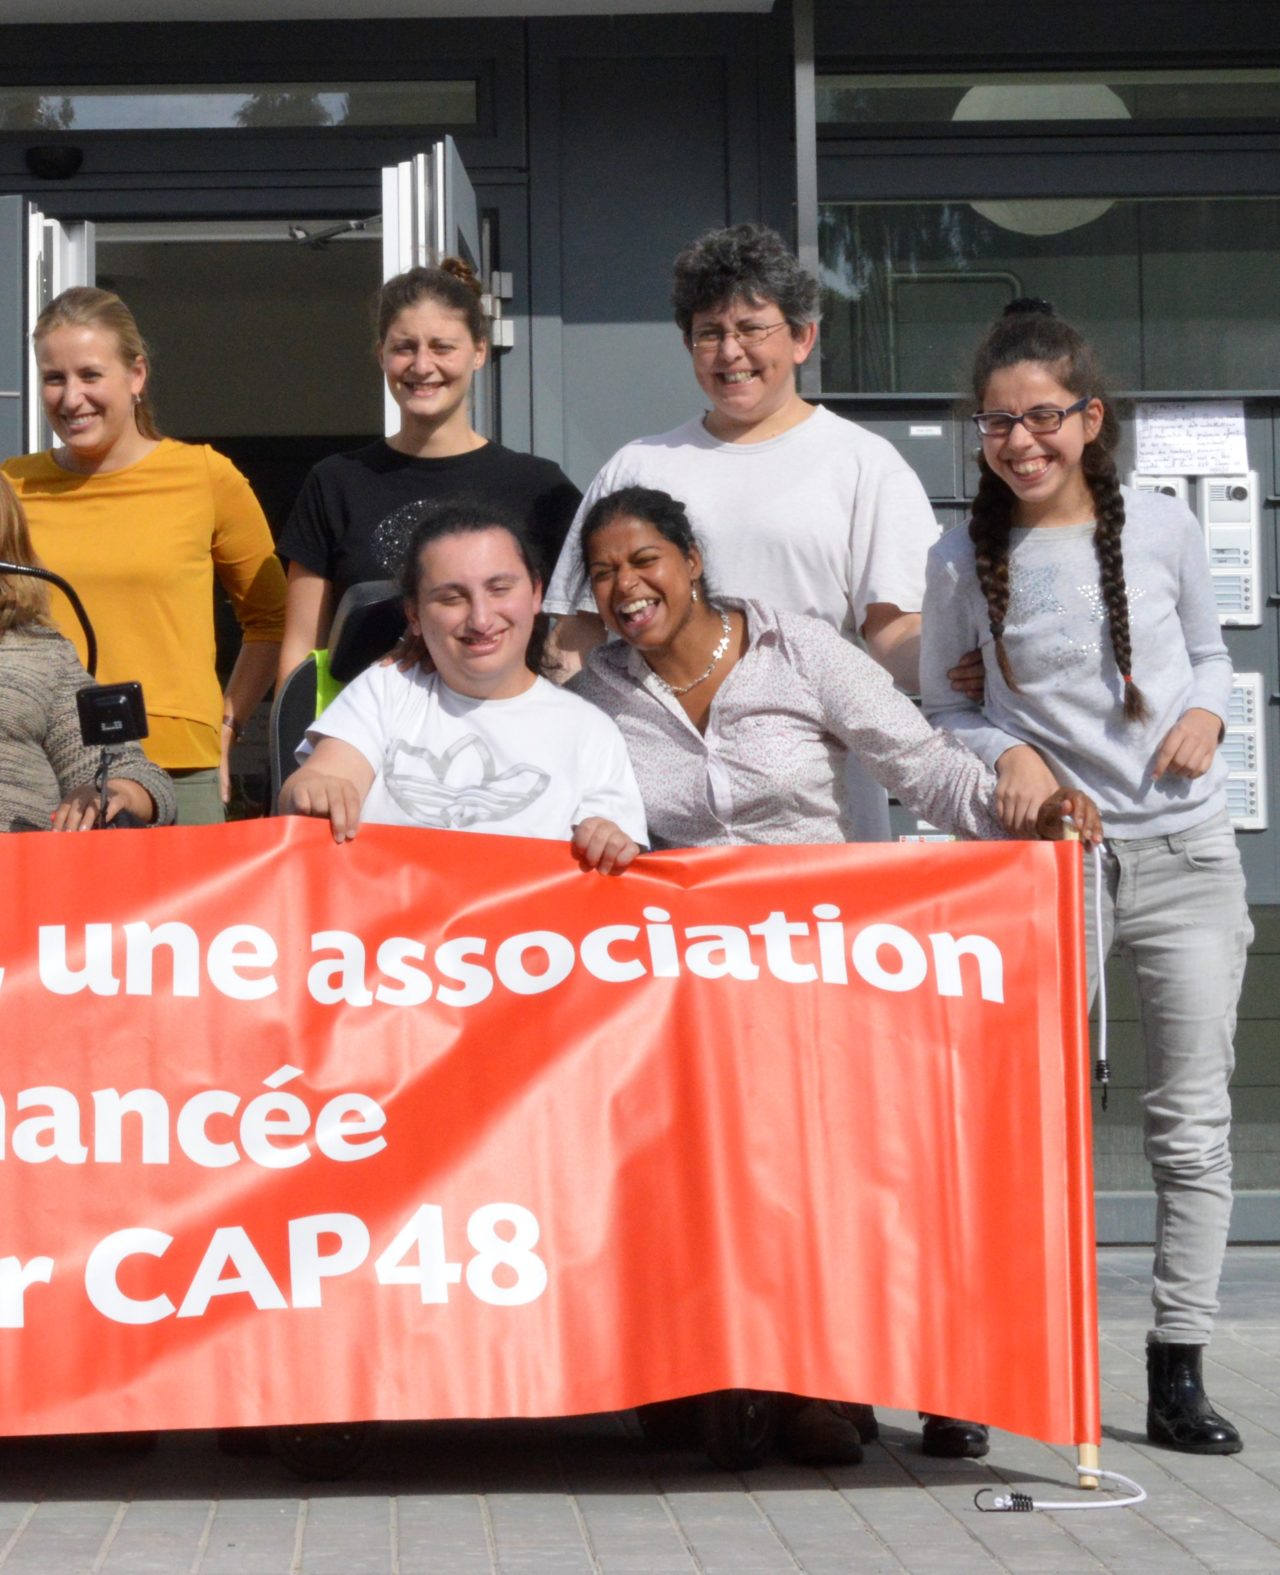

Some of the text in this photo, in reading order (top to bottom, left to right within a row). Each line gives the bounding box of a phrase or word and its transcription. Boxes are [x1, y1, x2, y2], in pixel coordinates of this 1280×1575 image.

[38, 920, 279, 1000] une
[307, 903, 1005, 1007] association
[84, 1202, 548, 1324] CAP48
